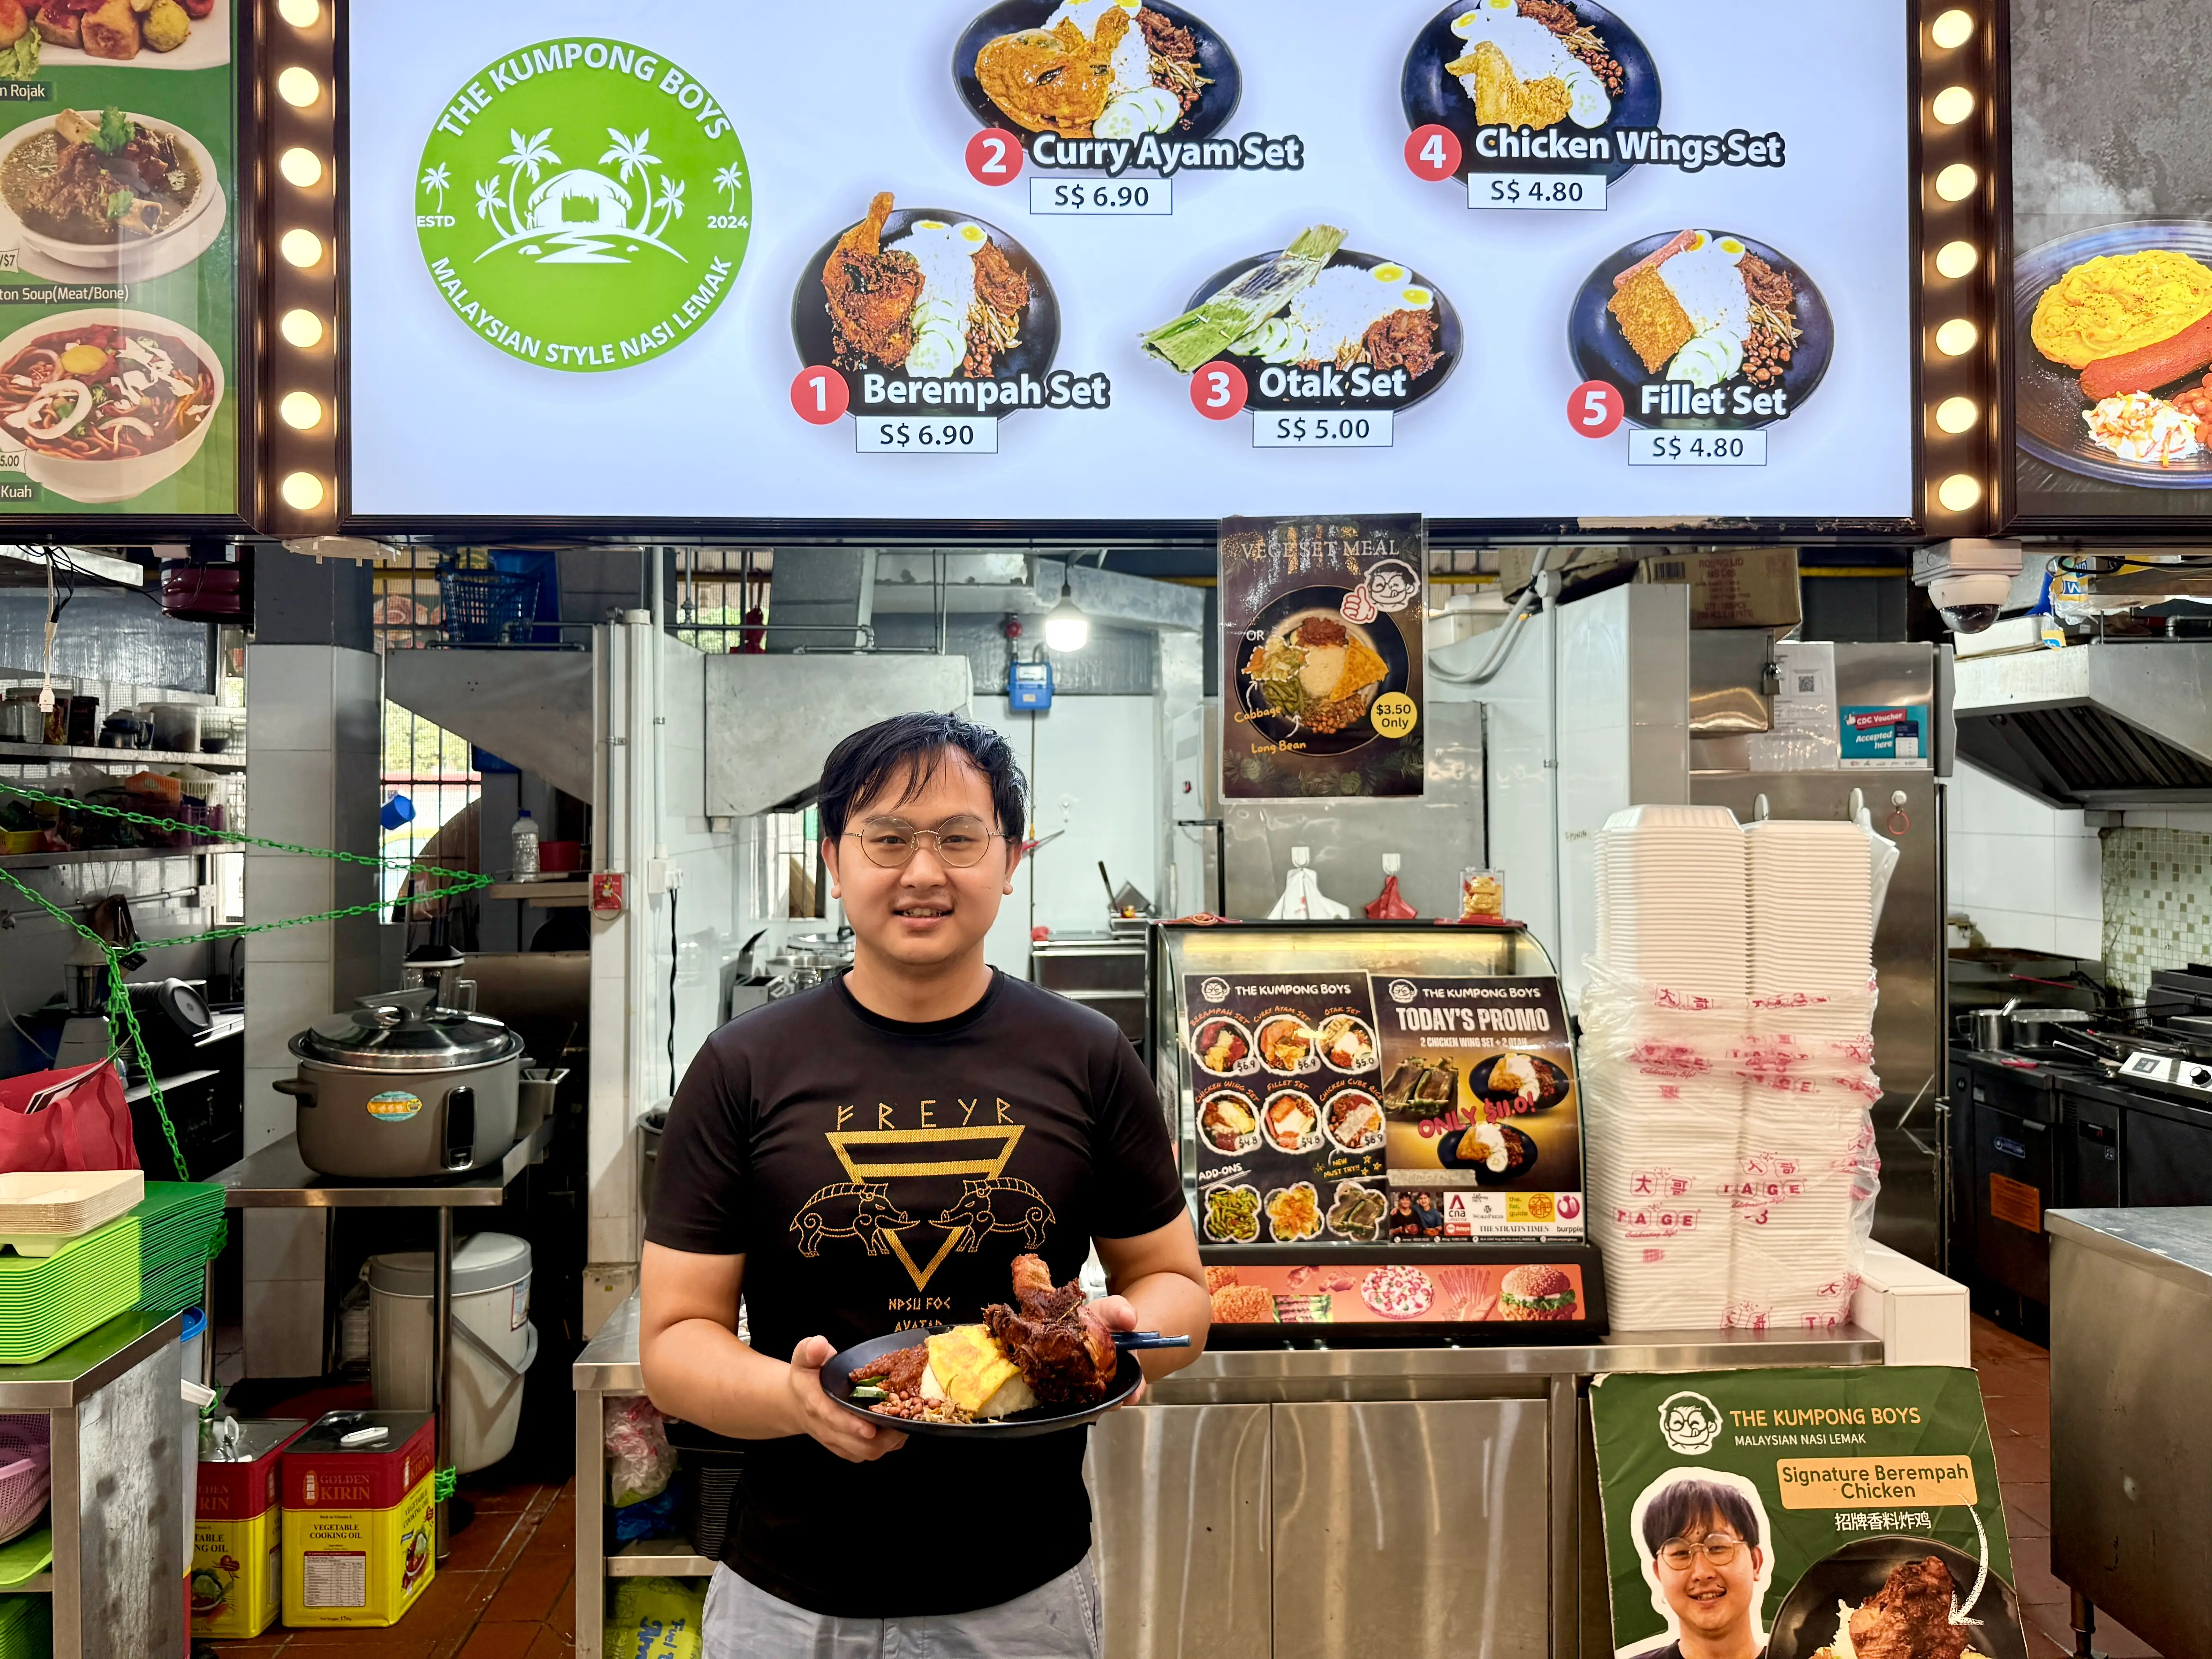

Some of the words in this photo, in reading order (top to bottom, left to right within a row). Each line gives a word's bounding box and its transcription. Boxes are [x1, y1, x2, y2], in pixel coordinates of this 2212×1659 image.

[11, 84, 45, 101] Rojak
[437, 81, 493, 137] THE
[488, 43, 659, 93] KUMPONG
[658, 67, 731, 140] BOYS
[981, 138, 1007, 173] 2
[1033, 135, 1122, 171] Curry
[1137, 136, 1239, 171] Ayam
[1243, 136, 1300, 167] Set
[1419, 135, 1447, 169] 4
[1475, 129, 1610, 159] Chicken
[1616, 131, 1725, 168] Wings
[1727, 133, 1782, 163] Set
[1055, 185, 1084, 208] S$
[1093, 187, 1149, 208] 6.90
[1491, 180, 1520, 203] S$
[1528, 181, 1583, 202] 4.80
[417, 215, 455, 228] ESTD
[707, 215, 749, 229] 2024
[22, 284, 129, 304] Soup(Meat/Bone)
[431, 257, 541, 358] MALAYSIAN
[545, 344, 615, 365] STYLE
[619, 321, 676, 361] NASI
[671, 255, 732, 330] LEMAK
[809, 376, 827, 411] 1
[863, 373, 1042, 412] Berempah
[1050, 374, 1106, 405] Set
[1206, 371, 1231, 407] 3
[1260, 366, 1344, 398] Otak
[1350, 367, 1407, 397] Set
[1582, 391, 1607, 426] 5
[1642, 383, 1726, 415] Fillet
[1732, 385, 1787, 415] Set
[880, 422, 910, 447] S$
[918, 424, 974, 445] 6.90
[1277, 417, 1307, 441] S$
[1315, 419, 1369, 439] 5.00
[1652, 436, 1681, 460] S$
[1690, 438, 1744, 457] 4.80
[1, 485, 32, 498] Kuah
[1342, 540, 1400, 557] MEAL
[1246, 630, 1265, 642] OR
[1233, 705, 1281, 723] Cabbage
[1376, 704, 1411, 716] $3.50
[1381, 717, 1409, 730] Only
[1857, 717, 1872, 726] CDC
[1873, 713, 1903, 723] Voucher
[1856, 730, 1893, 743] Accepted
[1251, 741, 1276, 754] Long
[1279, 740, 1306, 752] Bean
[1874, 741, 1893, 750] here
[1235, 985, 1257, 996] THE
[1259, 984, 1319, 995] KUMPONG
[1320, 983, 1352, 995] BOYS
[1422, 988, 1445, 998] THE
[1446, 988, 1507, 999] KUMPONG
[1508, 987, 1541, 998] BOYS
[1189, 1007, 1233, 1027] BERAMPAH
[1234, 1012, 1251, 1025] SET
[1253, 1007, 1272, 1023] CURRY
[1274, 1005, 1295, 1014] AYAM
[1296, 1010, 1311, 1022] SET
[1324, 1006, 1344, 1016] OTAK
[1346, 1007, 1361, 1016] SET
[1396, 1007, 1475, 1032] TODAY'S
[1477, 1007, 1551, 1032] PROMO
[1420, 1036, 1426, 1047] 2
[1427, 1037, 1459, 1048] CHICKEN
[1459, 1036, 1481, 1047] WING
[1481, 1036, 1494, 1047] SET
[1502, 1036, 1508, 1047] 2
[1237, 1060, 1256, 1072] $6.9
[1298, 1059, 1316, 1071] $6.9
[1355, 1056, 1375, 1068] $5.0
[1640, 1068, 1677, 1078] Celebrating
[1195, 1082, 1222, 1103] CHICKEN
[1224, 1080, 1245, 1092] WING
[1246, 1088, 1260, 1102] SET
[1267, 1079, 1292, 1092] FILLET
[1294, 1080, 1309, 1091] SET
[1319, 1080, 1345, 1102] CHICKEN
[1349, 1078, 1368, 1088] CUBE
[1368, 1084, 1383, 1100] RICE
[1418, 1106, 1477, 1138] ONLY
[1238, 1135, 1258, 1147] $4.8
[1301, 1135, 1320, 1147] $4.8
[1332, 1158, 1348, 1167] NEW
[1198, 1163, 1243, 1181] ADD-ONS
[1323, 1167, 1342, 1178] MUST
[1343, 1164, 1360, 1174] TRY!!
[1617, 1210, 1693, 1226] TAGE
[1729, 1410, 1768, 1427] THE
[1773, 1408, 1866, 1427] KUMPONG
[1871, 1407, 1921, 1425] BOYS
[1735, 1433, 1798, 1447] MALAYSIAN
[1801, 1432, 1827, 1445] NASI
[1829, 1432, 1866, 1445] LEMAK
[320, 1475, 369, 1484] GOLDEN
[1781, 1464, 1871, 1487] Signature
[1874, 1462, 1969, 1485] Berempah
[320, 1486, 370, 1500] KIRIN
[1840, 1481, 1916, 1499] Chicken
[1834, 1510, 1932, 1531] 招牌香料炸鸡
